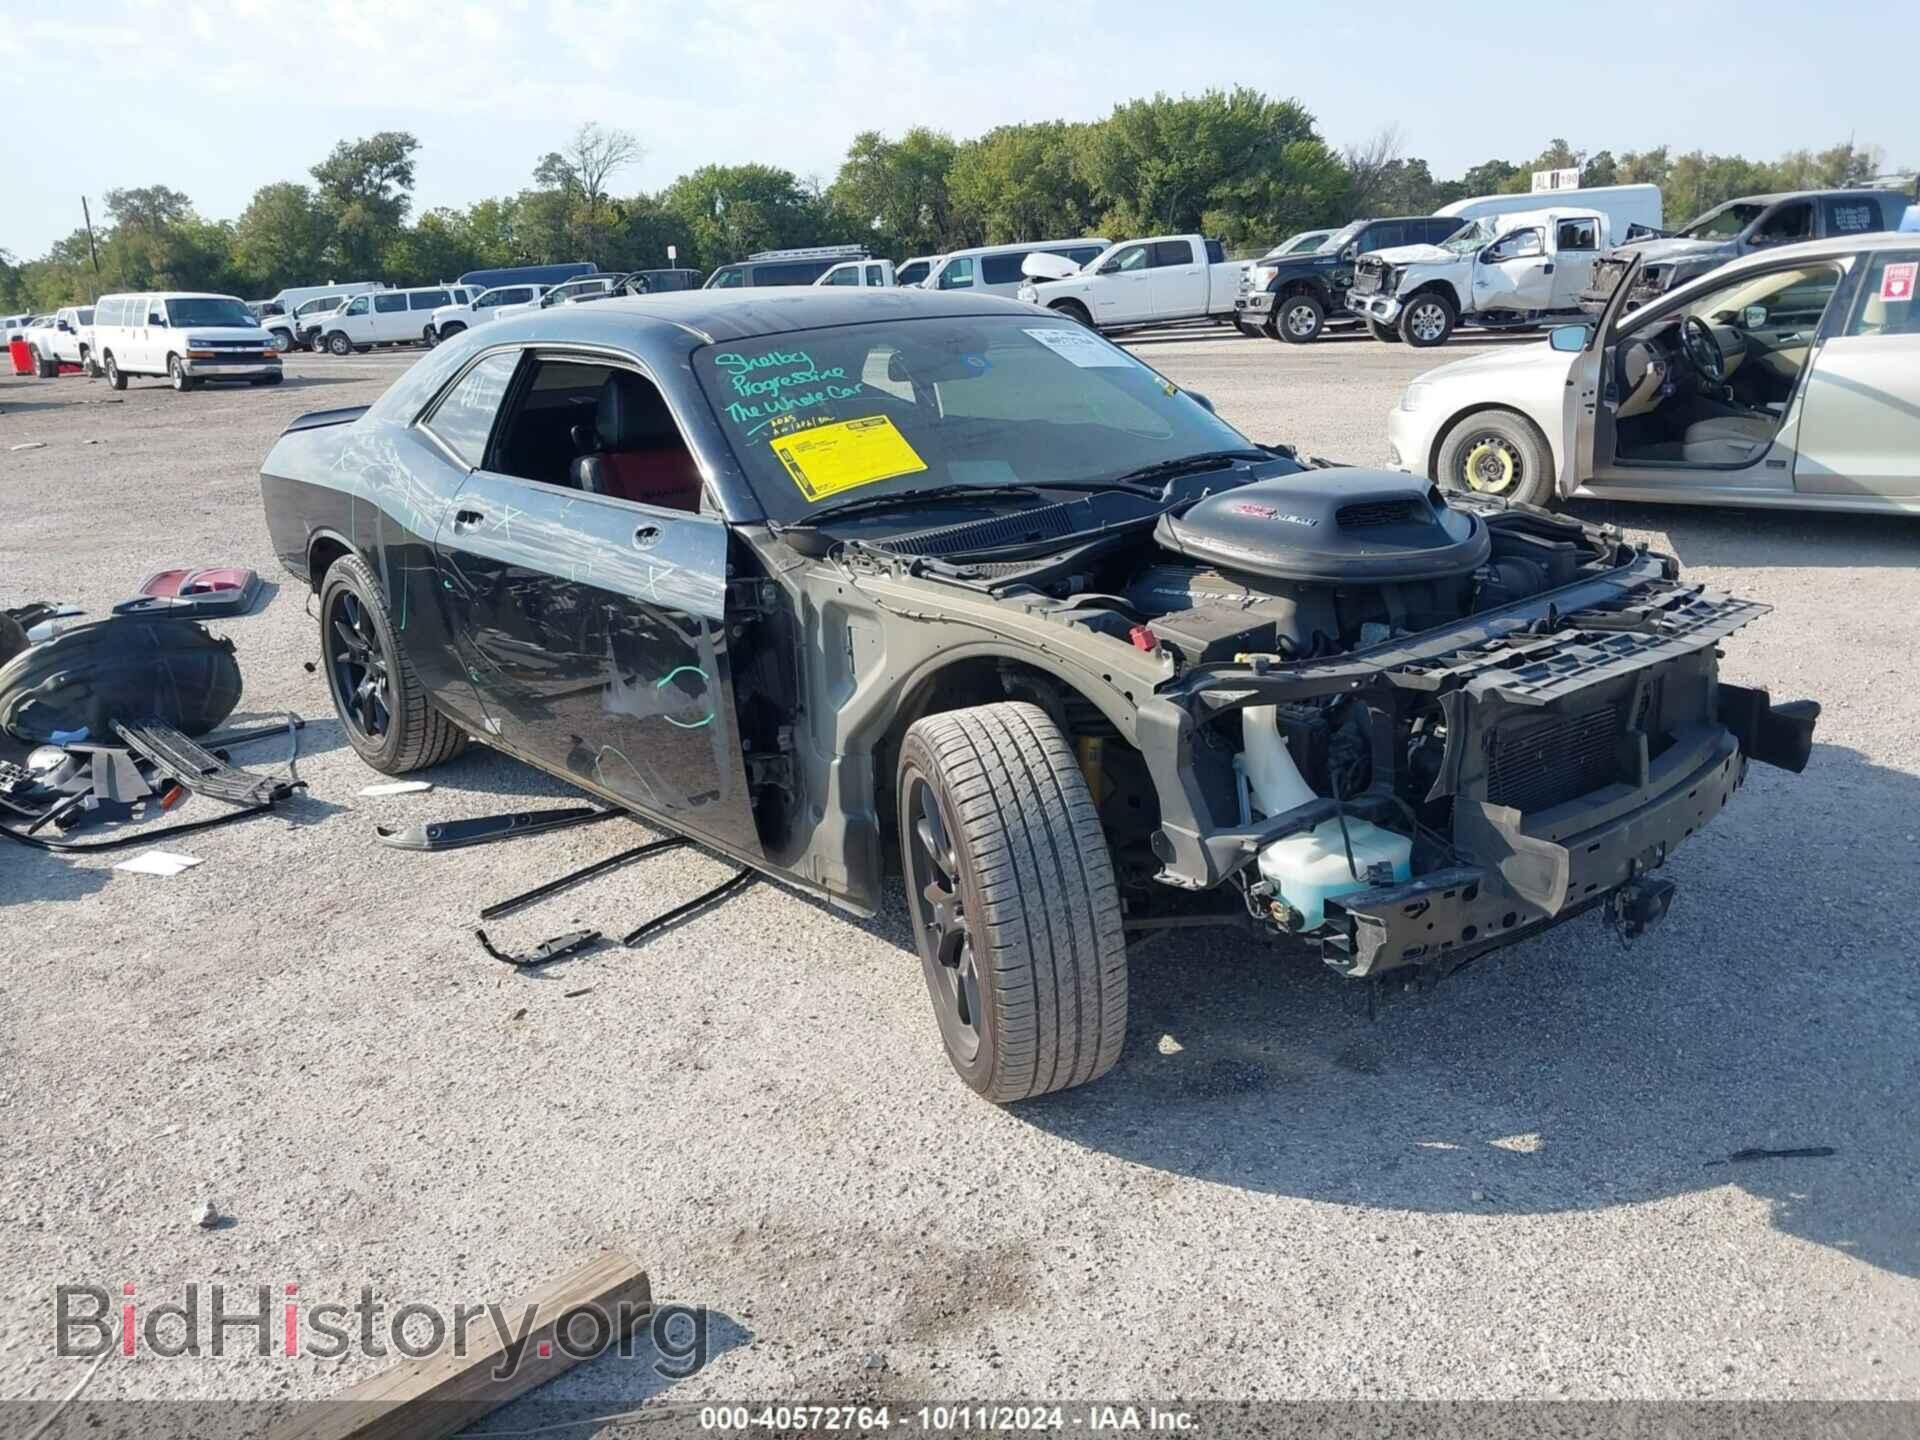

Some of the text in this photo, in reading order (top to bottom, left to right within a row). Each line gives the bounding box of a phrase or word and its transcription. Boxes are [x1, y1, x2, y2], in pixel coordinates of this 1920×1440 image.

[715, 351, 815, 374] Shelby
[725, 402, 766, 423] The
[826, 383, 864, 399] Car
